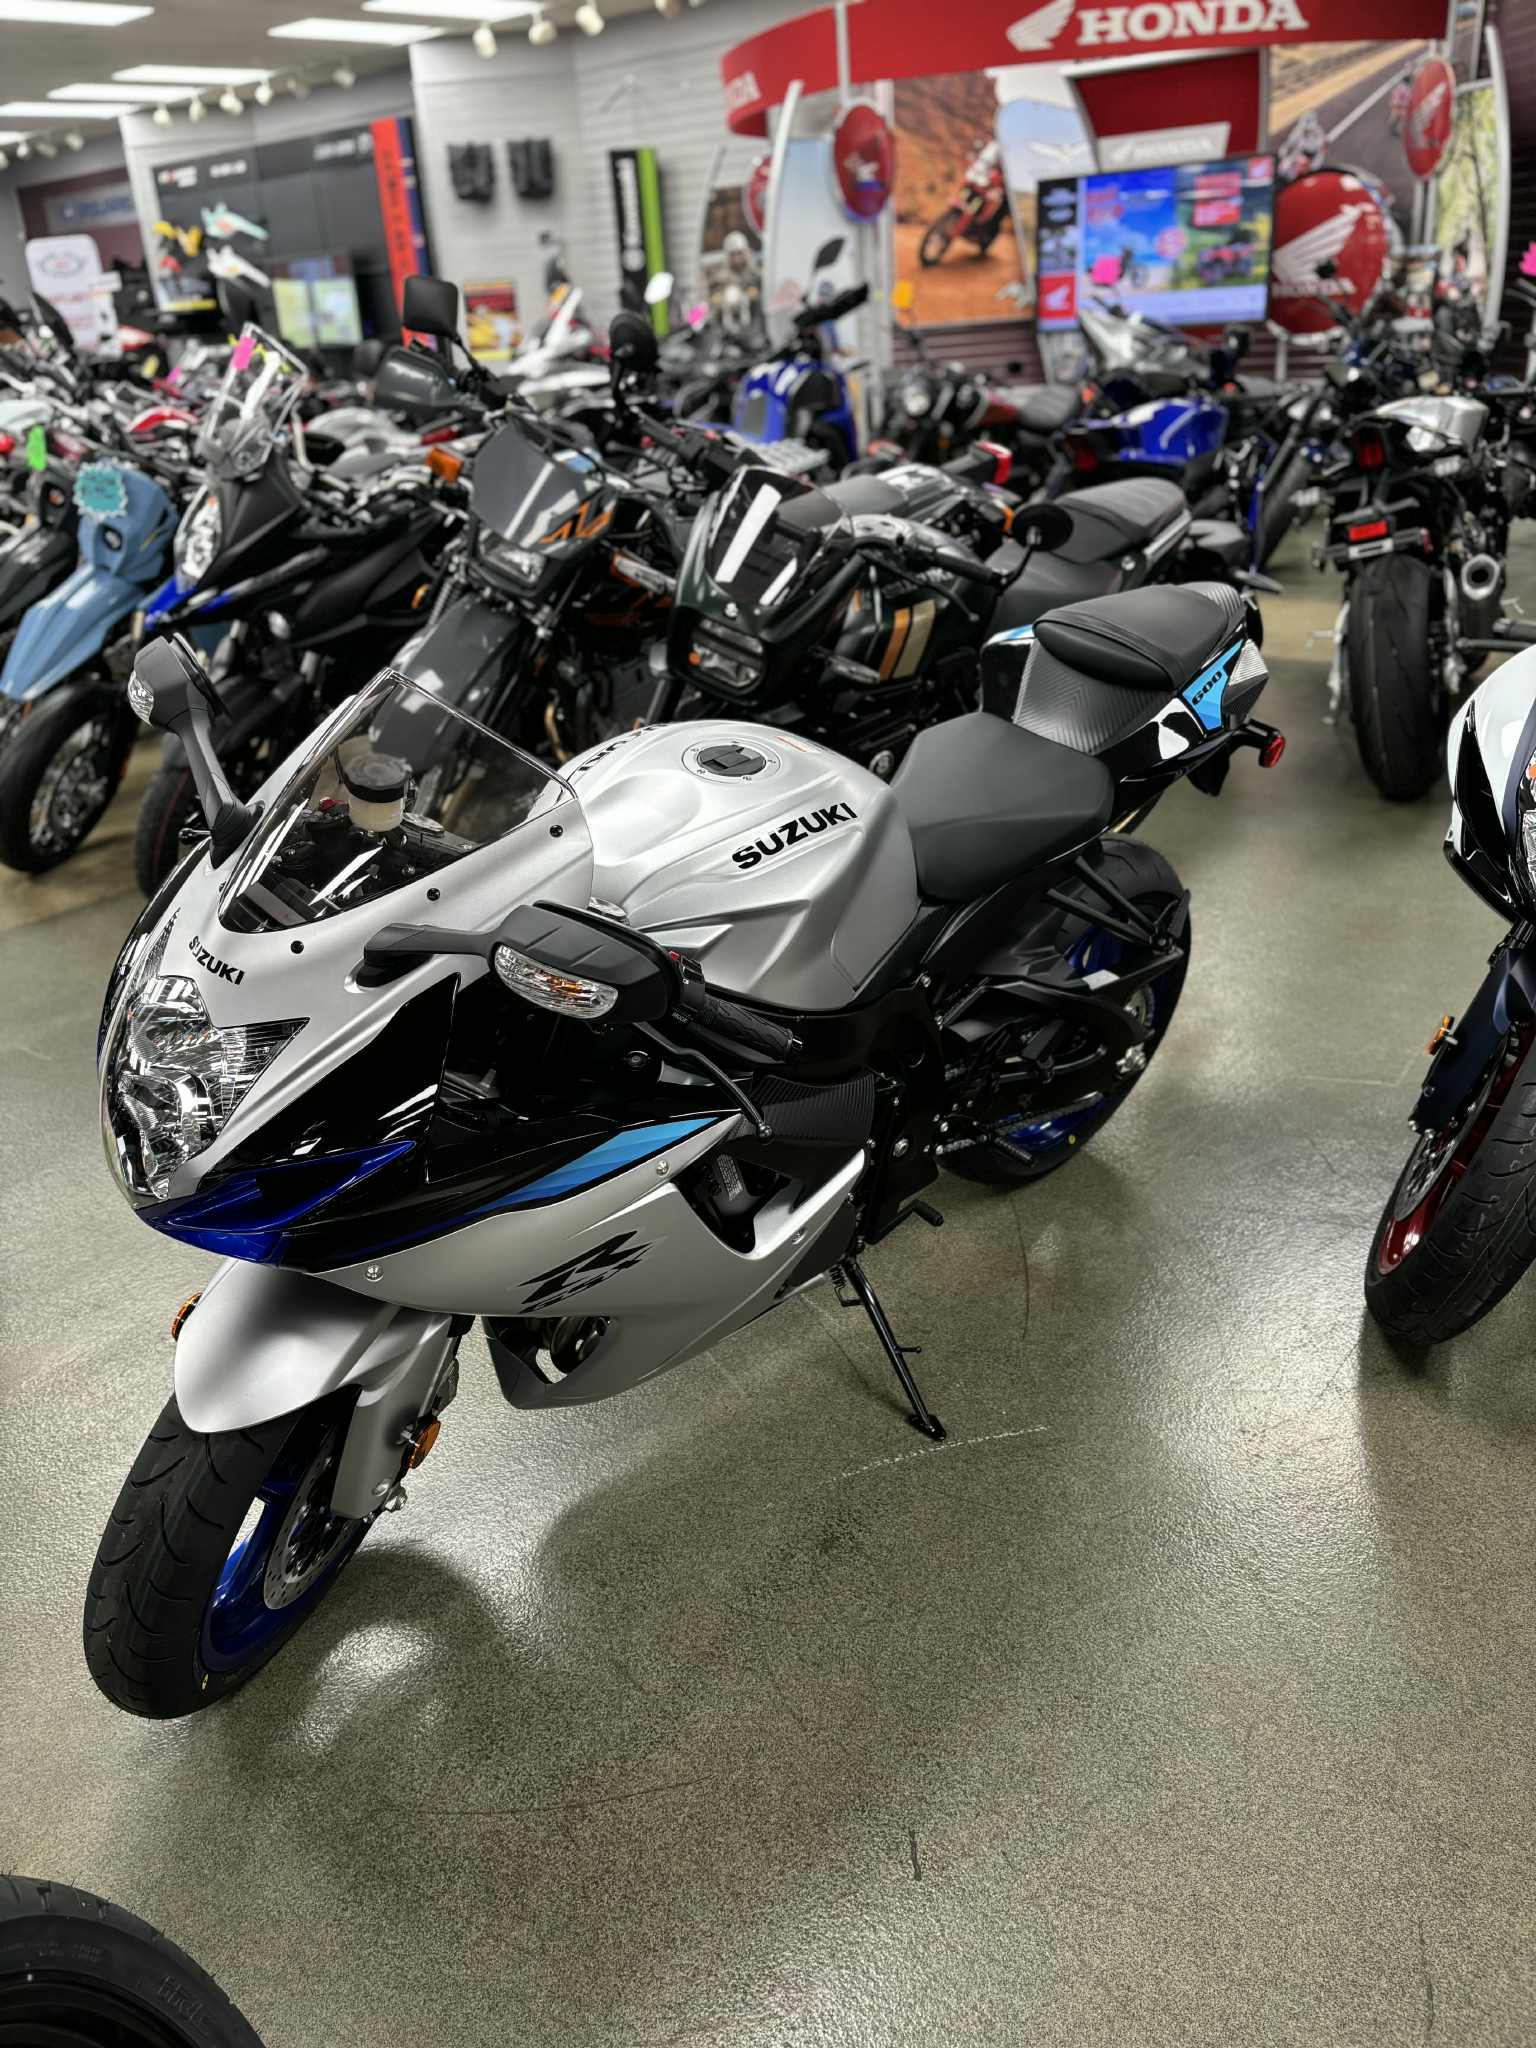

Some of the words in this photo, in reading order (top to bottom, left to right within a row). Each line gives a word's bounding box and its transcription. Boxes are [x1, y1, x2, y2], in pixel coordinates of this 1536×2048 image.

[1076, 0, 1309, 46] HONDA
[1191, 670, 1222, 705] 600
[731, 802, 858, 870] SUZUKI
[188, 935, 245, 986] SUZUKI
